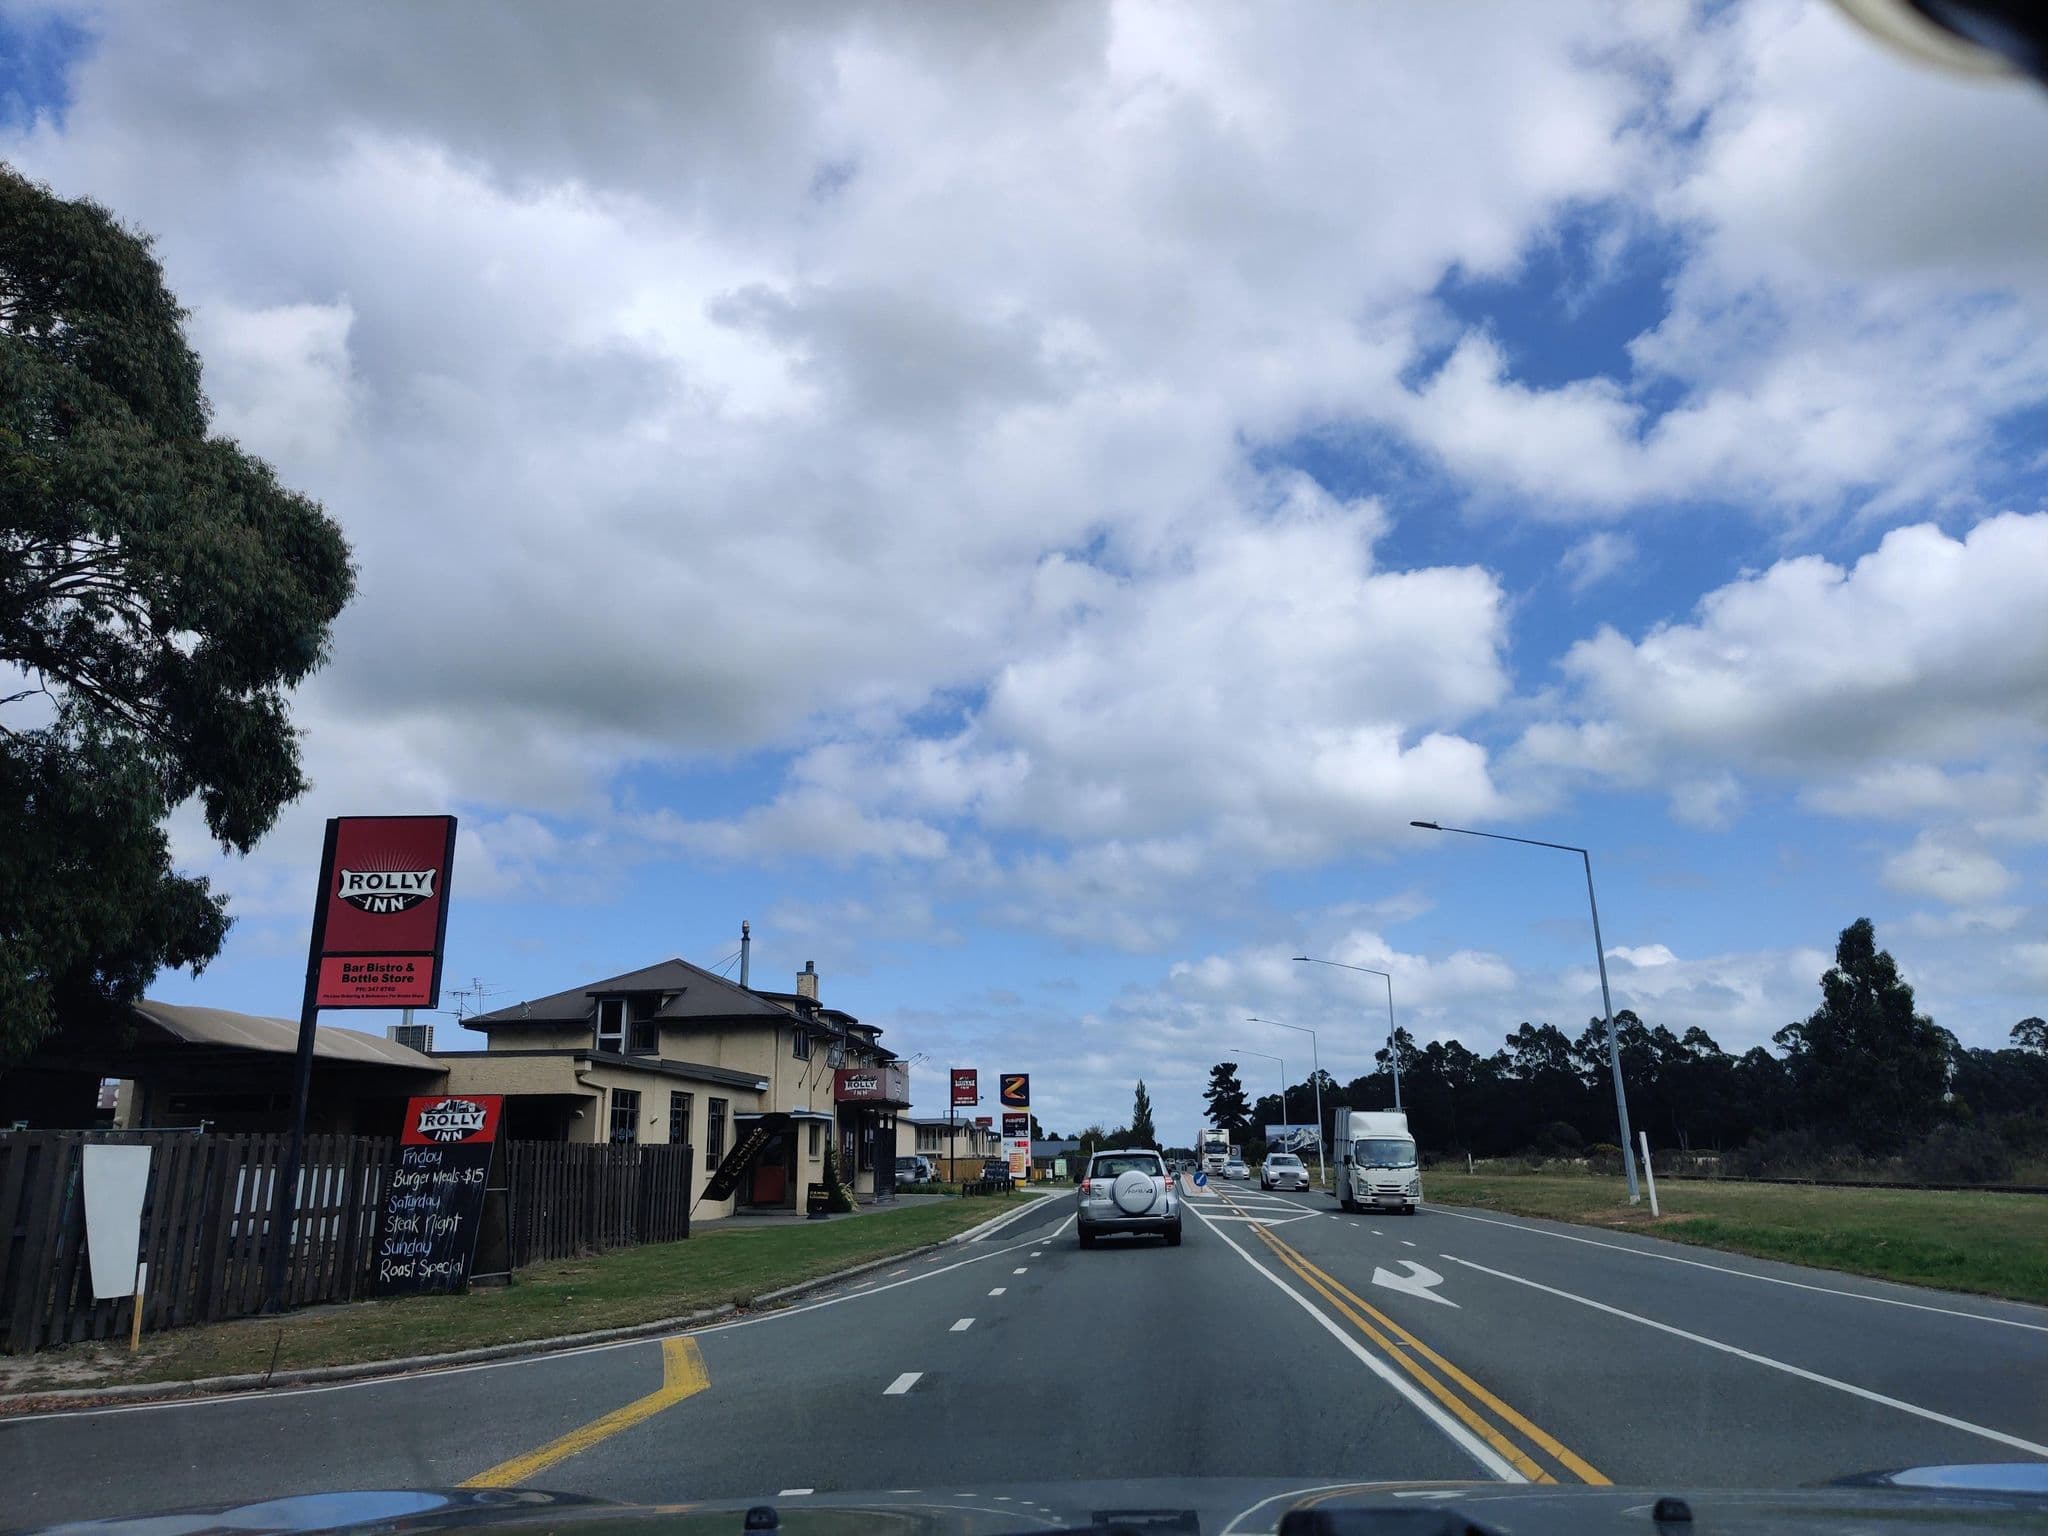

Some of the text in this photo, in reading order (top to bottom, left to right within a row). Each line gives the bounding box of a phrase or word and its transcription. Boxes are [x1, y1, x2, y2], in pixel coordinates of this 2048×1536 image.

[349, 873, 429, 890] ROLLY
[364, 895, 405, 912] INN
[343, 962, 415, 973] Bar Bistro &
[341, 973, 414, 984] Bottle Store
[847, 1080, 875, 1088] ROLLY
[1004, 1076, 1026, 1100] Z
[425, 1114, 480, 1126] ROLLY
[435, 1130, 463, 1141] INN
[402, 1147, 443, 1165] Friday
[393, 1169, 430, 1191] Burger
[389, 1193, 441, 1213] Saturday
[385, 1214, 420, 1233] Steak
[380, 1238, 432, 1257] Sunday
[380, 1253, 464, 1283] Roast Special
